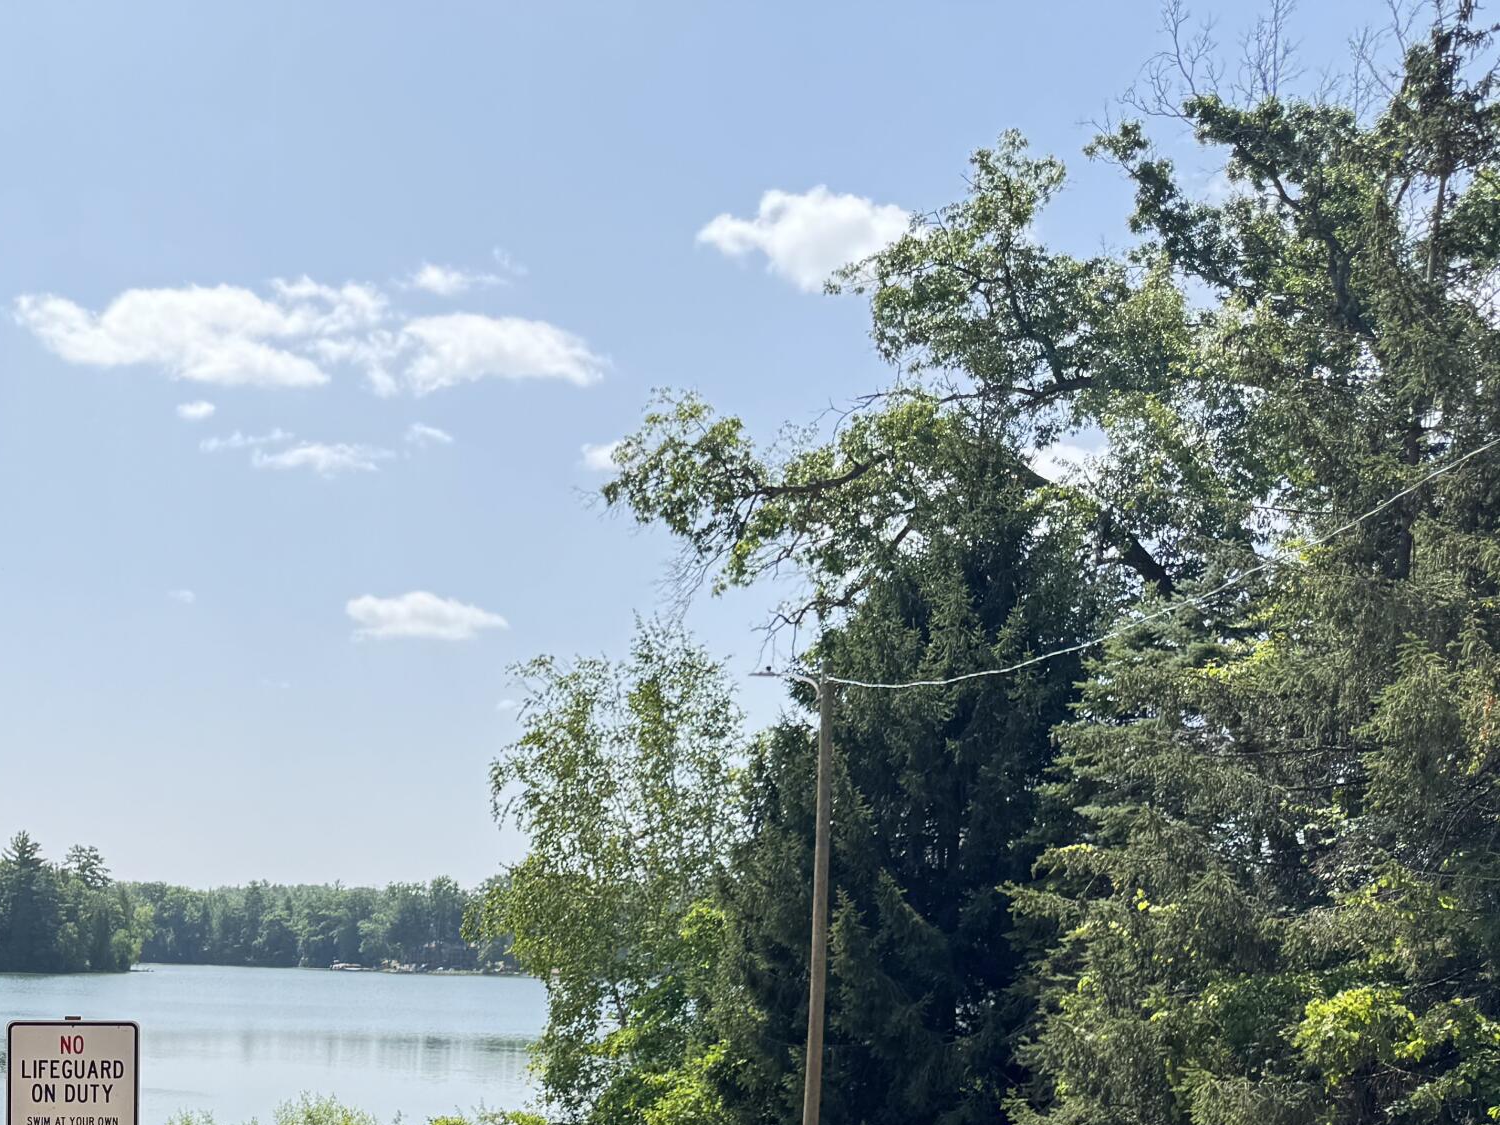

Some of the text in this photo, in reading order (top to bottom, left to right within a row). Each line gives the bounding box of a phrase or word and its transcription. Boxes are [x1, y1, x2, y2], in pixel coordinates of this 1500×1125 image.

[60, 1035, 85, 1054] NO
[21, 1060, 124, 1079] LIFEGUARD
[31, 1083, 114, 1103] ON DUTY
